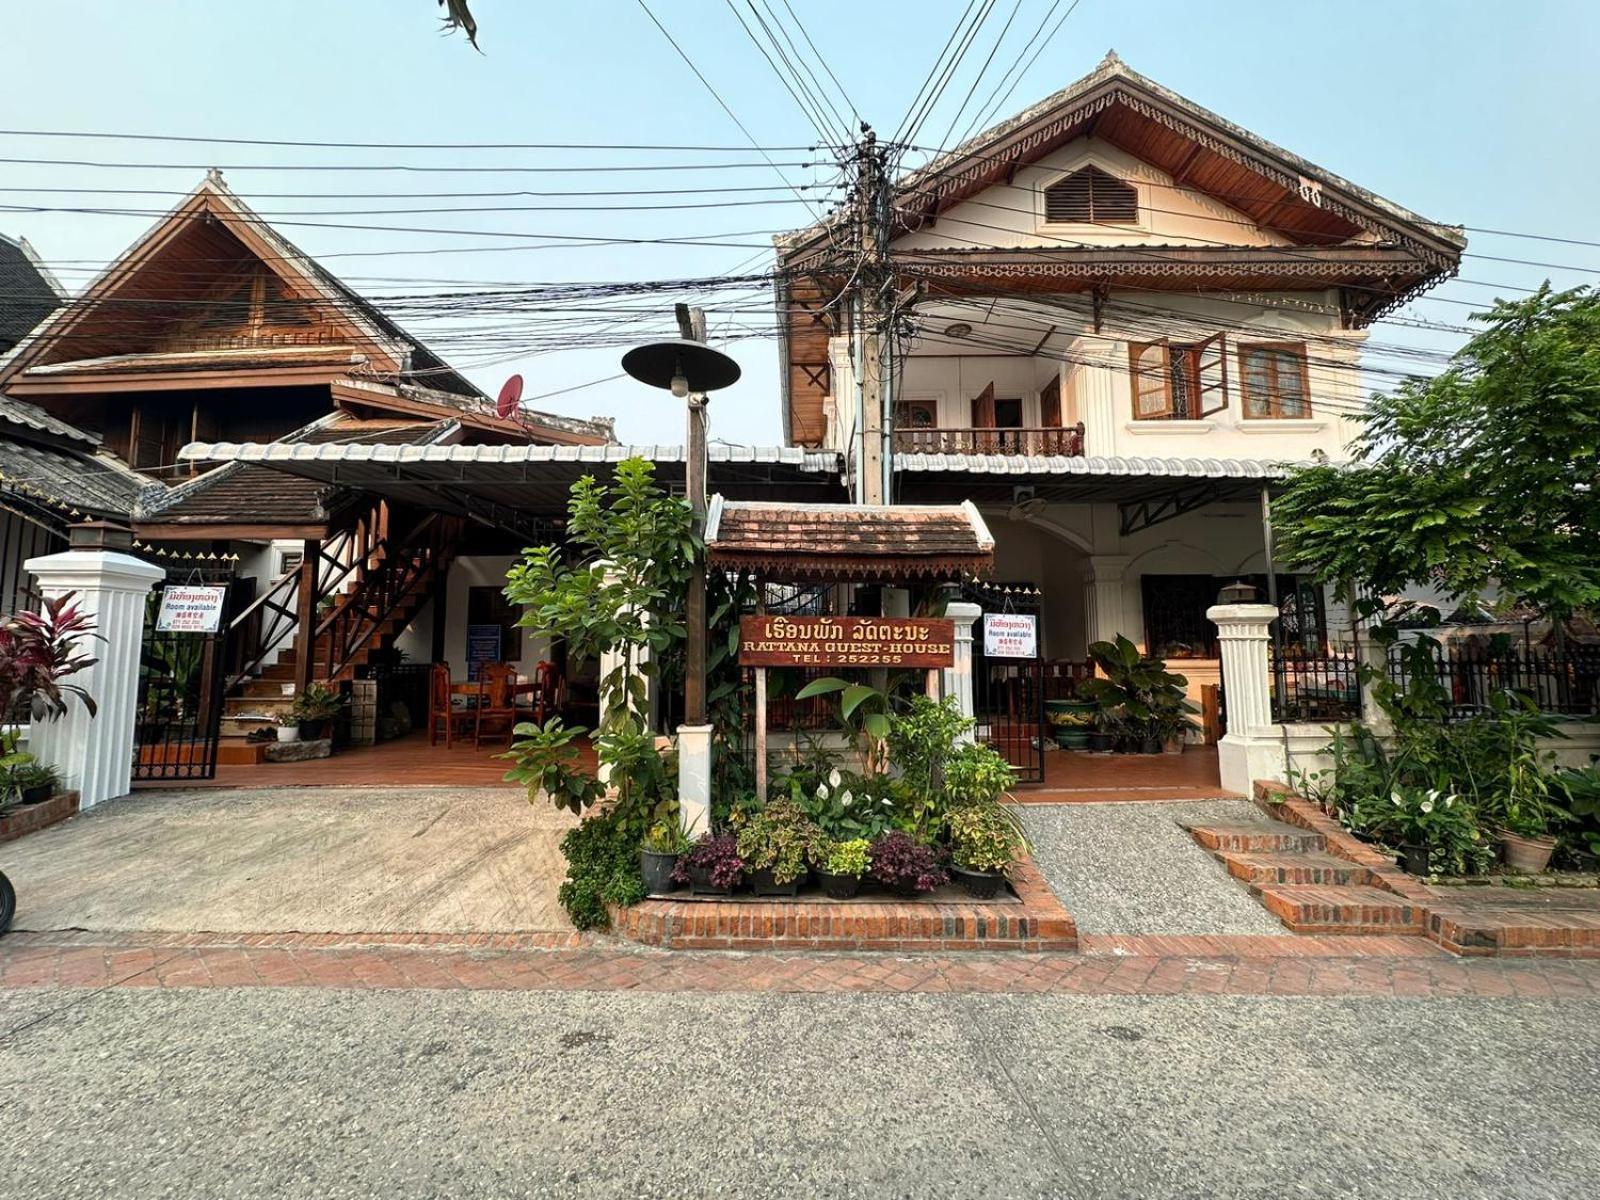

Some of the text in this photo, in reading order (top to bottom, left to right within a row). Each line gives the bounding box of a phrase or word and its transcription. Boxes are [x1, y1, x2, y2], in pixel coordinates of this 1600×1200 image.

[166, 602, 217, 611] Room available
[743, 641, 950, 654] RATTANA GUEST-HOUSE
[838, 654, 902, 663] 252255
